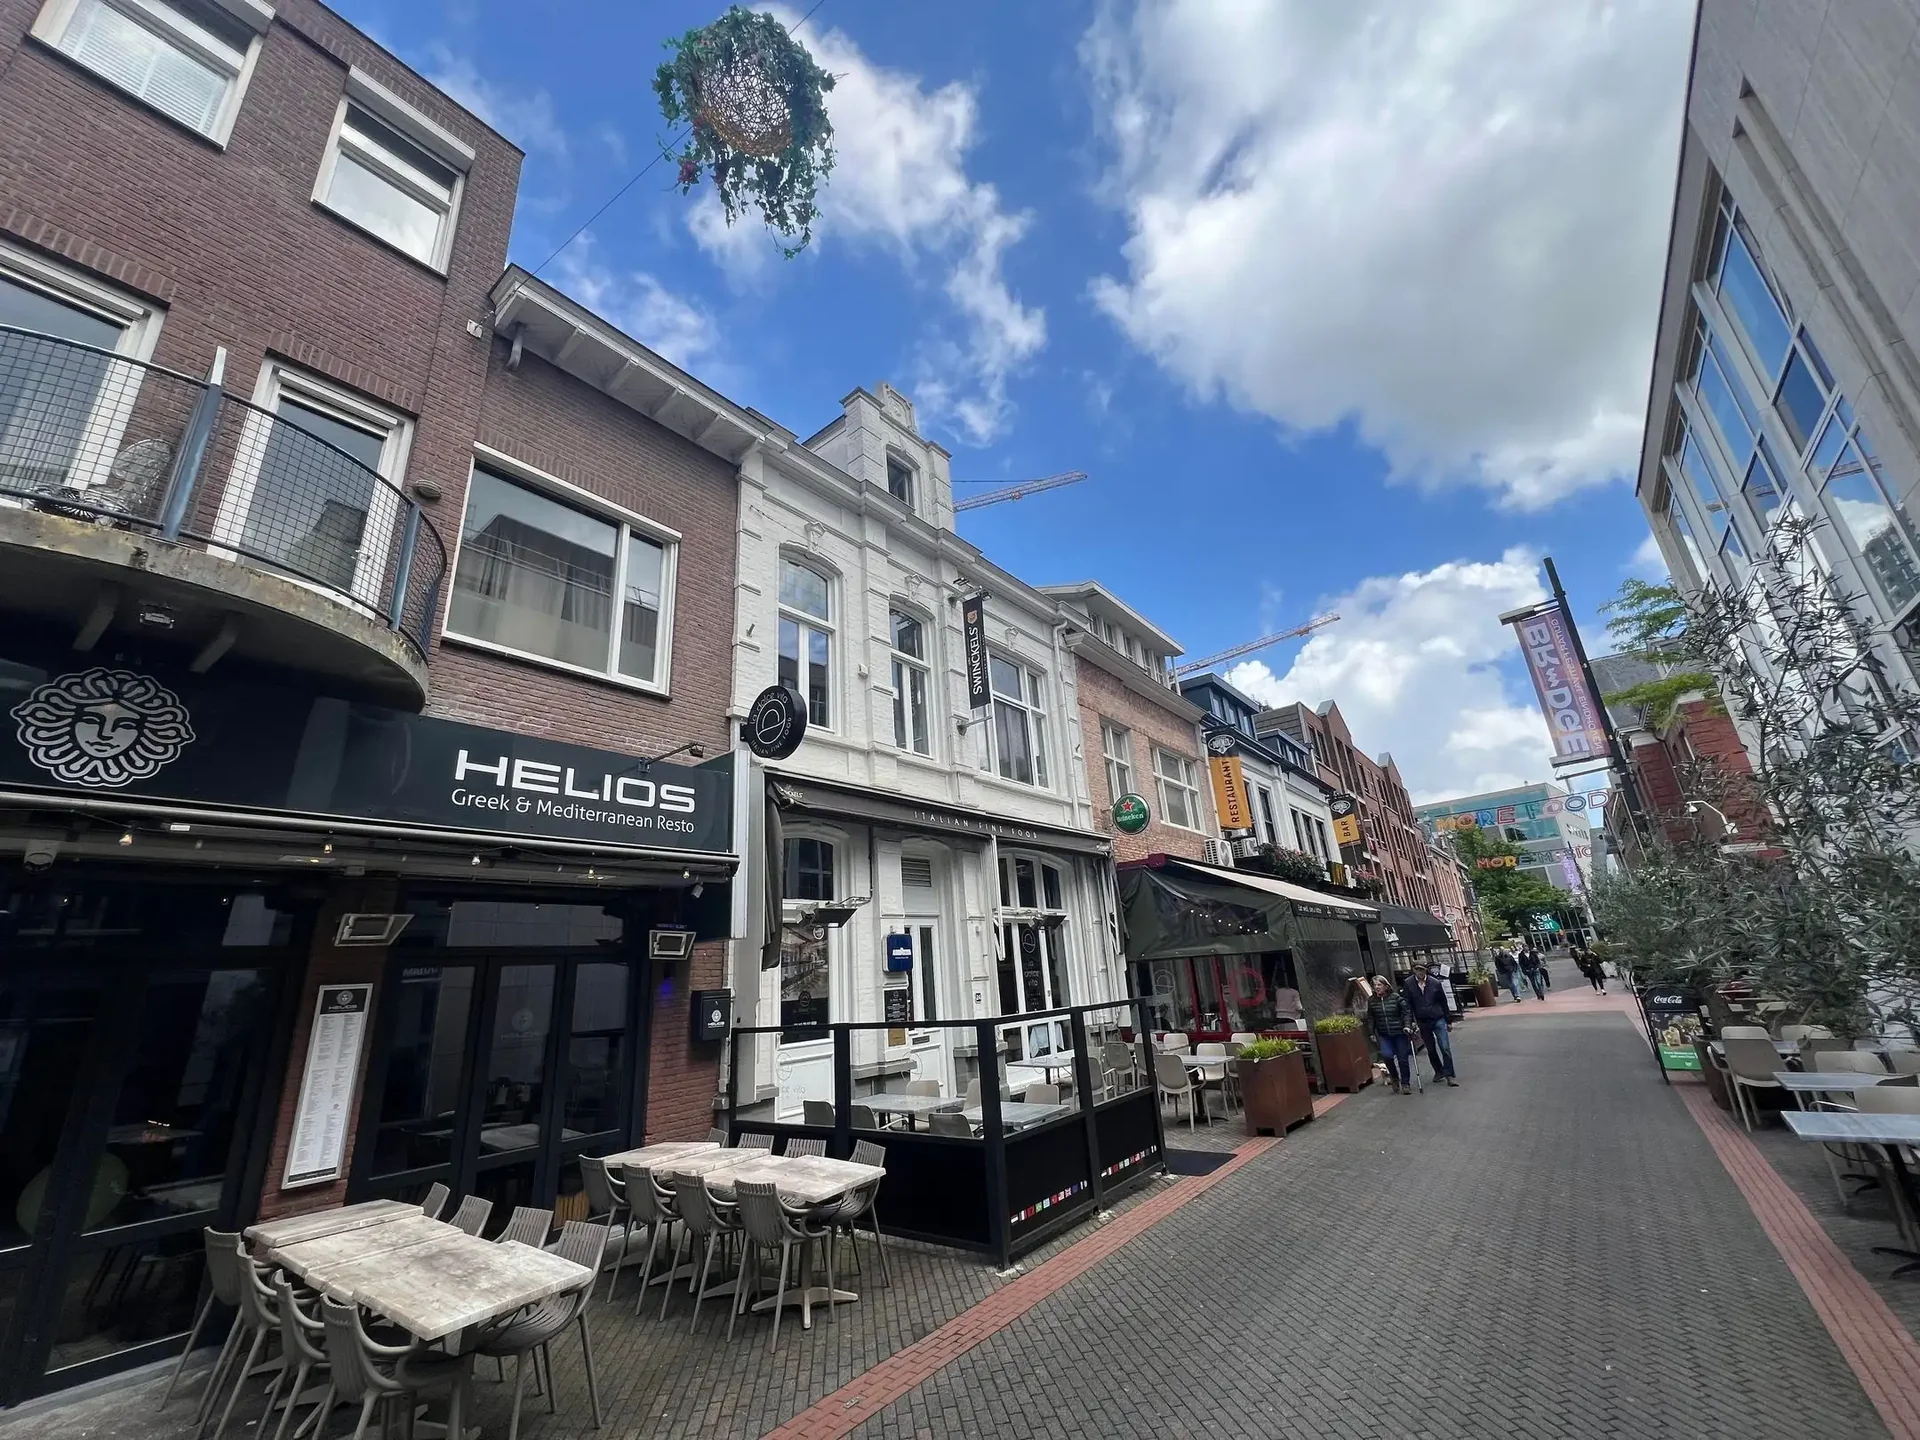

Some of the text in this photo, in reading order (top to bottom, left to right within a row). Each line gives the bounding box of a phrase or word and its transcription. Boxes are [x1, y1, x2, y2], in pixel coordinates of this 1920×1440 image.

[454, 749, 696, 814] HELIOS
[1221, 759, 1240, 823] RESTAURANT
[450, 788, 695, 834] Greek & Mediterranean Resto
[913, 811, 1038, 840] ITALIAN FINE FOOD
[1340, 820, 1351, 837] BAR
[1435, 790, 1610, 832] MORE FOOD
[1476, 852, 1536, 870] MORE
